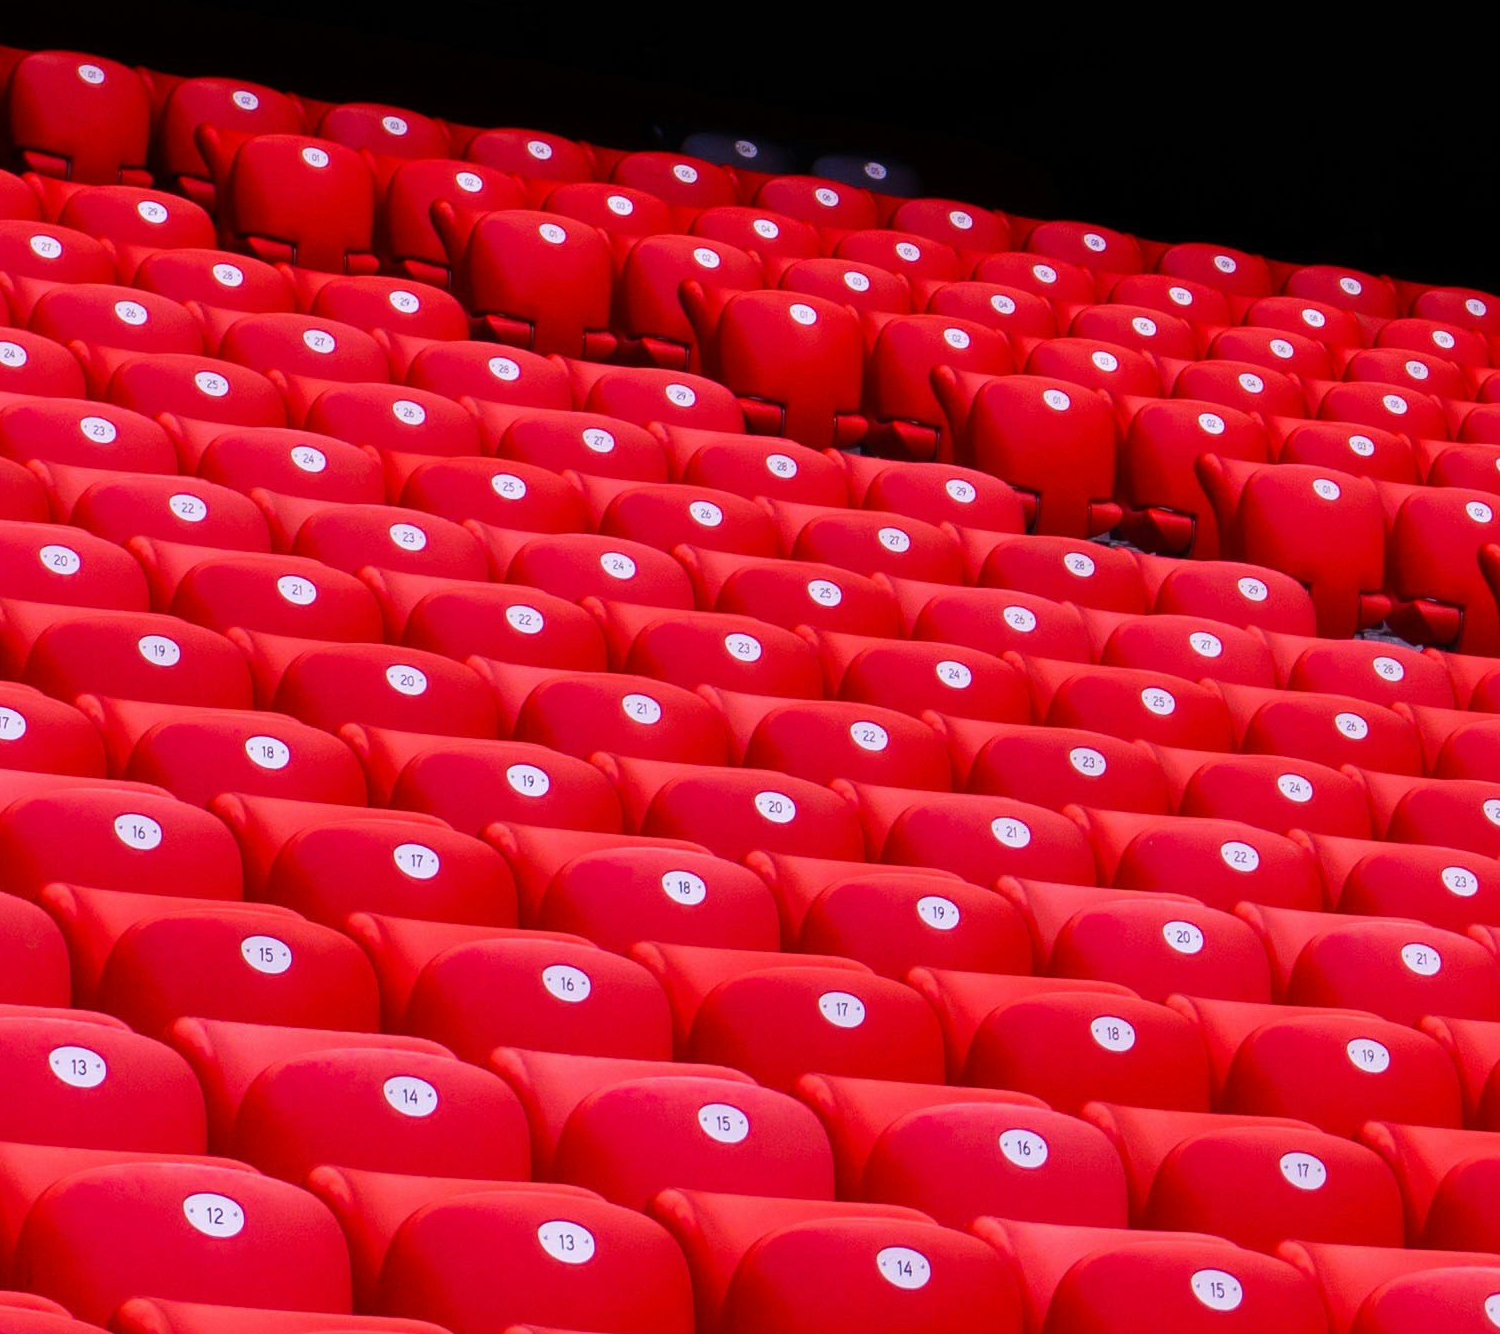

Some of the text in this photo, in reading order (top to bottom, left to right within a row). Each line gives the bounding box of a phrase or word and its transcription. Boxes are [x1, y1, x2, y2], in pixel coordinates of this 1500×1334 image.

[53, 554, 68, 567] 20
[948, 667, 961, 680] 24
[261, 745, 275, 760] 18
[522, 774, 535, 788] 19
[768, 800, 783, 814] 20
[132, 825, 146, 840] 16
[411, 853, 424, 868] 17
[1234, 850, 1248, 864] 22
[1454, 875, 1467, 888] 23
[932, 905, 945, 920] 19
[259, 947, 274, 963] 15
[561, 976, 575, 992] 16
[836, 1002, 849, 1017] 17
[1107, 1026, 1120, 1041] 18
[71, 1059, 87, 1076] 13
[402, 1088, 419, 1105] 14
[716, 1115, 731, 1132] 15
[1017, 1140, 1031, 1156] 16
[1297, 1162, 1310, 1178] 17
[206, 1207, 225, 1225] 12
[558, 1234, 575, 1251] 13
[897, 1259, 913, 1278] 14
[1210, 1281, 1225, 1299] 15
